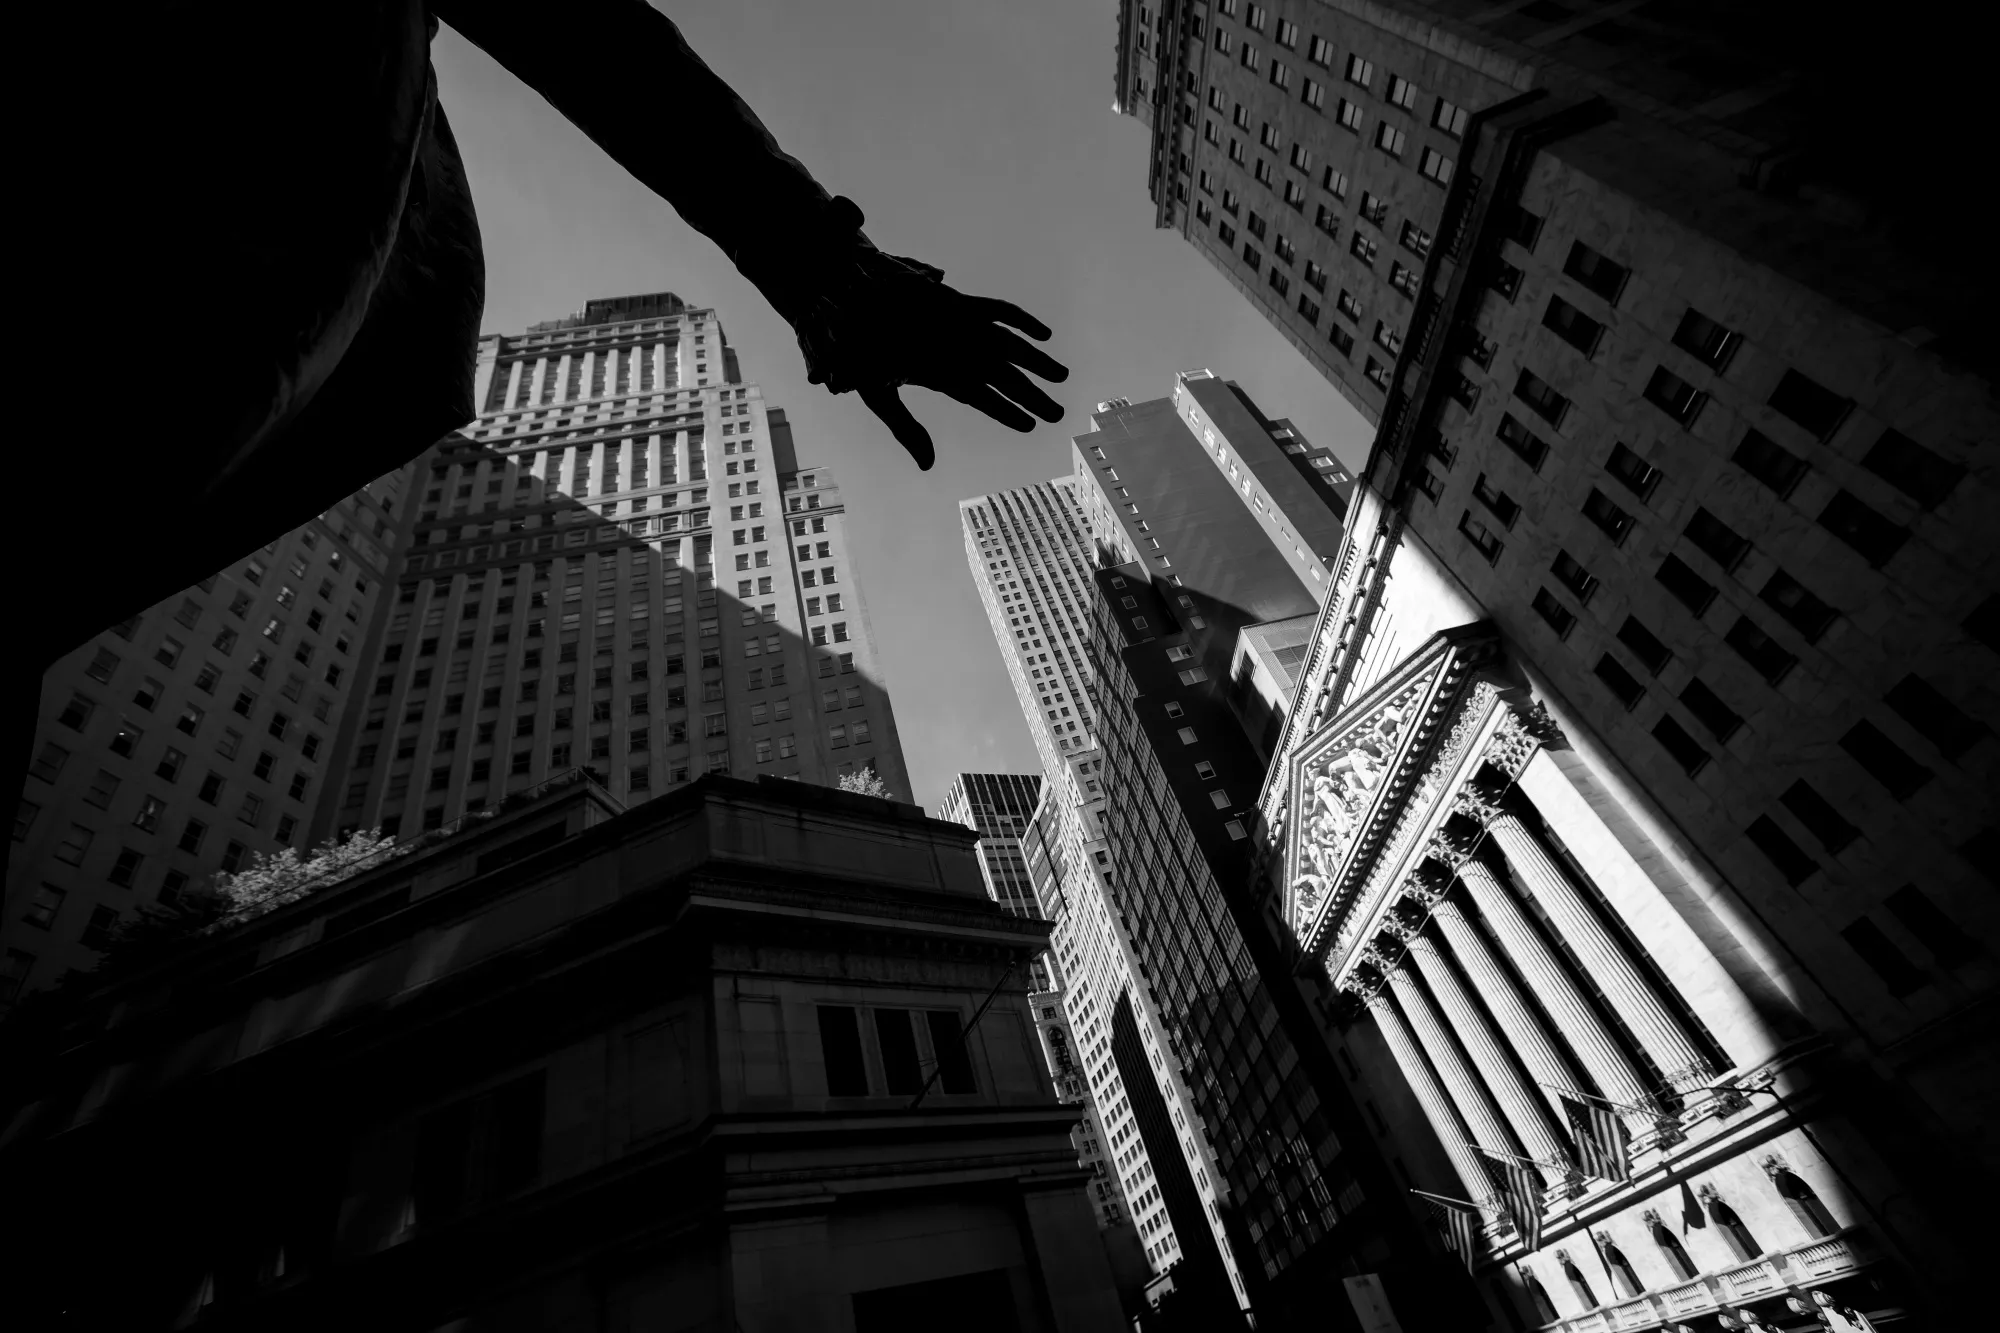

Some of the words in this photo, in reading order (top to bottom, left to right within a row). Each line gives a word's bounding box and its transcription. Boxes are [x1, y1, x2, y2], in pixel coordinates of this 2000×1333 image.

[1359, 886, 1377, 908] YORK
[1371, 858, 1392, 886] STOCK
[1388, 808, 1421, 857] EXCHANGE
